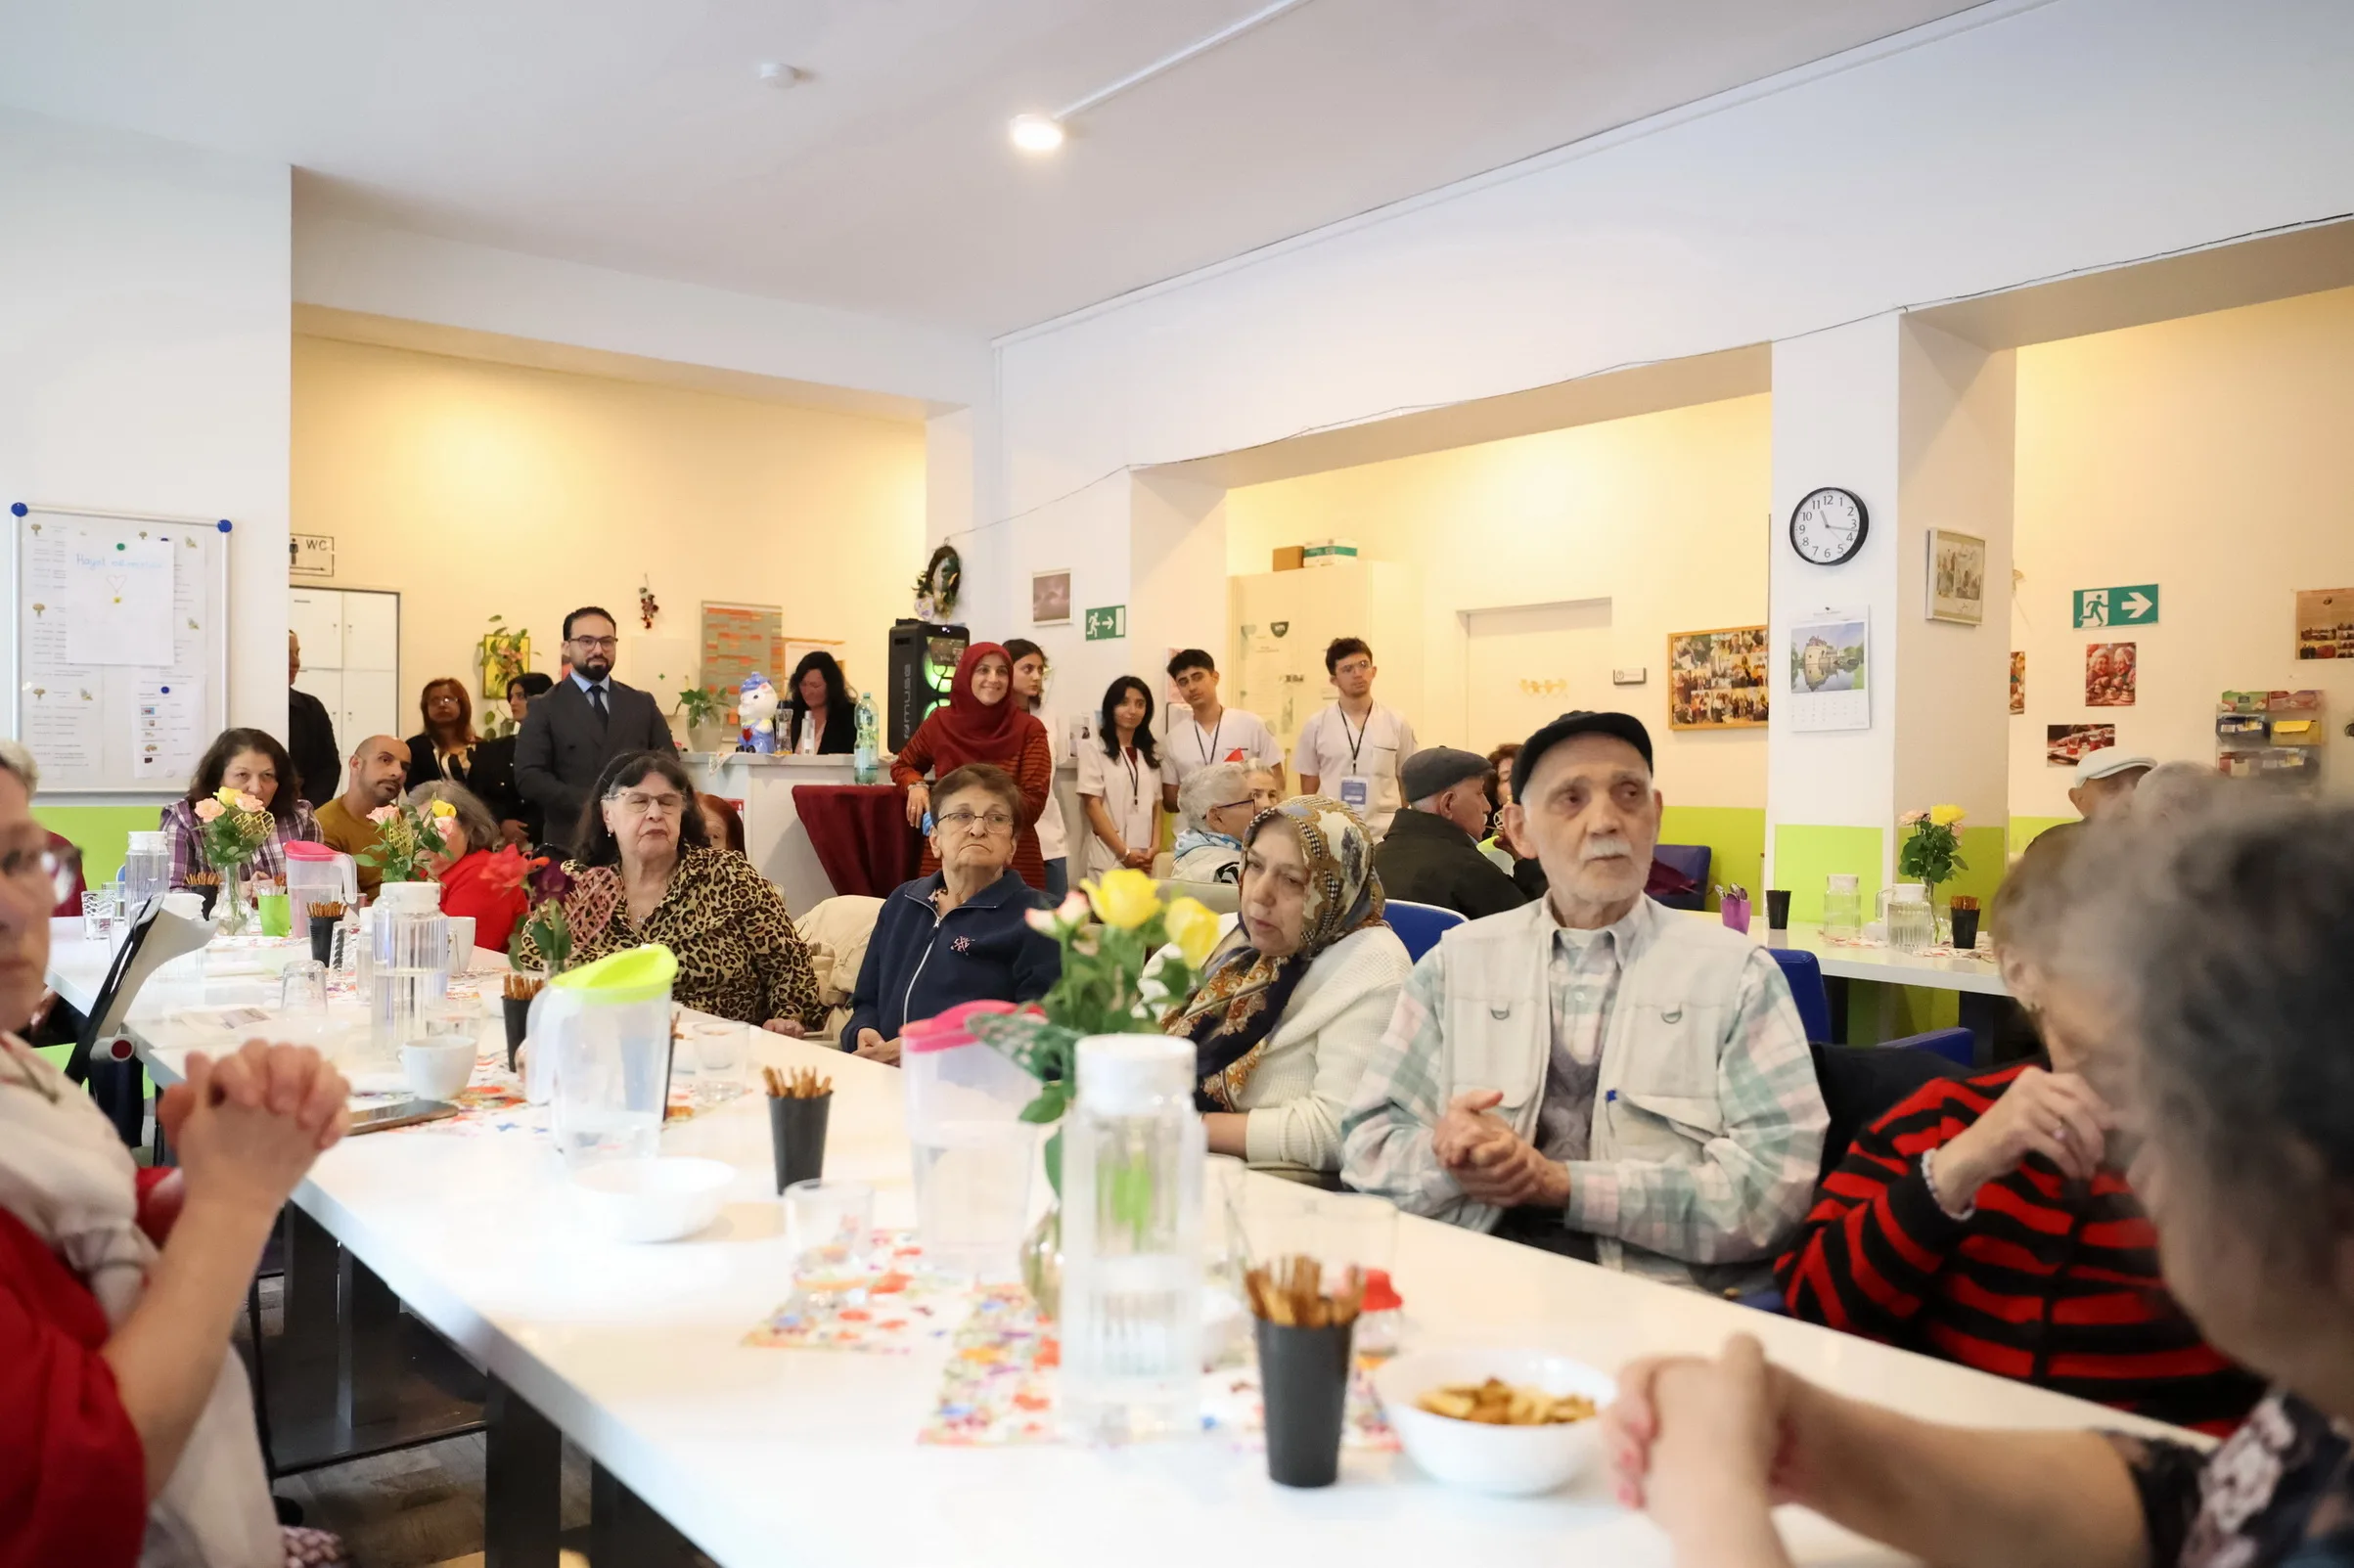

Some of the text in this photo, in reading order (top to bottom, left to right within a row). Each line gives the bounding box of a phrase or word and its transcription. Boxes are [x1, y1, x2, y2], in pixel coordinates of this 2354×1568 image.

[1812, 500, 1820, 510] 11
[1823, 495, 1833, 506] 12
[1847, 506, 1855, 516] 2
[1802, 512, 1813, 521] 10
[1851, 518, 1857, 529] 3
[1798, 524, 1806, 534] 9
[1802, 537, 1809, 547] 8
[1846, 532, 1854, 542] 4
[305, 539, 328, 551] WC
[1837, 543, 1844, 554] 5
[1812, 546, 1819, 556] 7
[1824, 548, 1831, 558] 6
